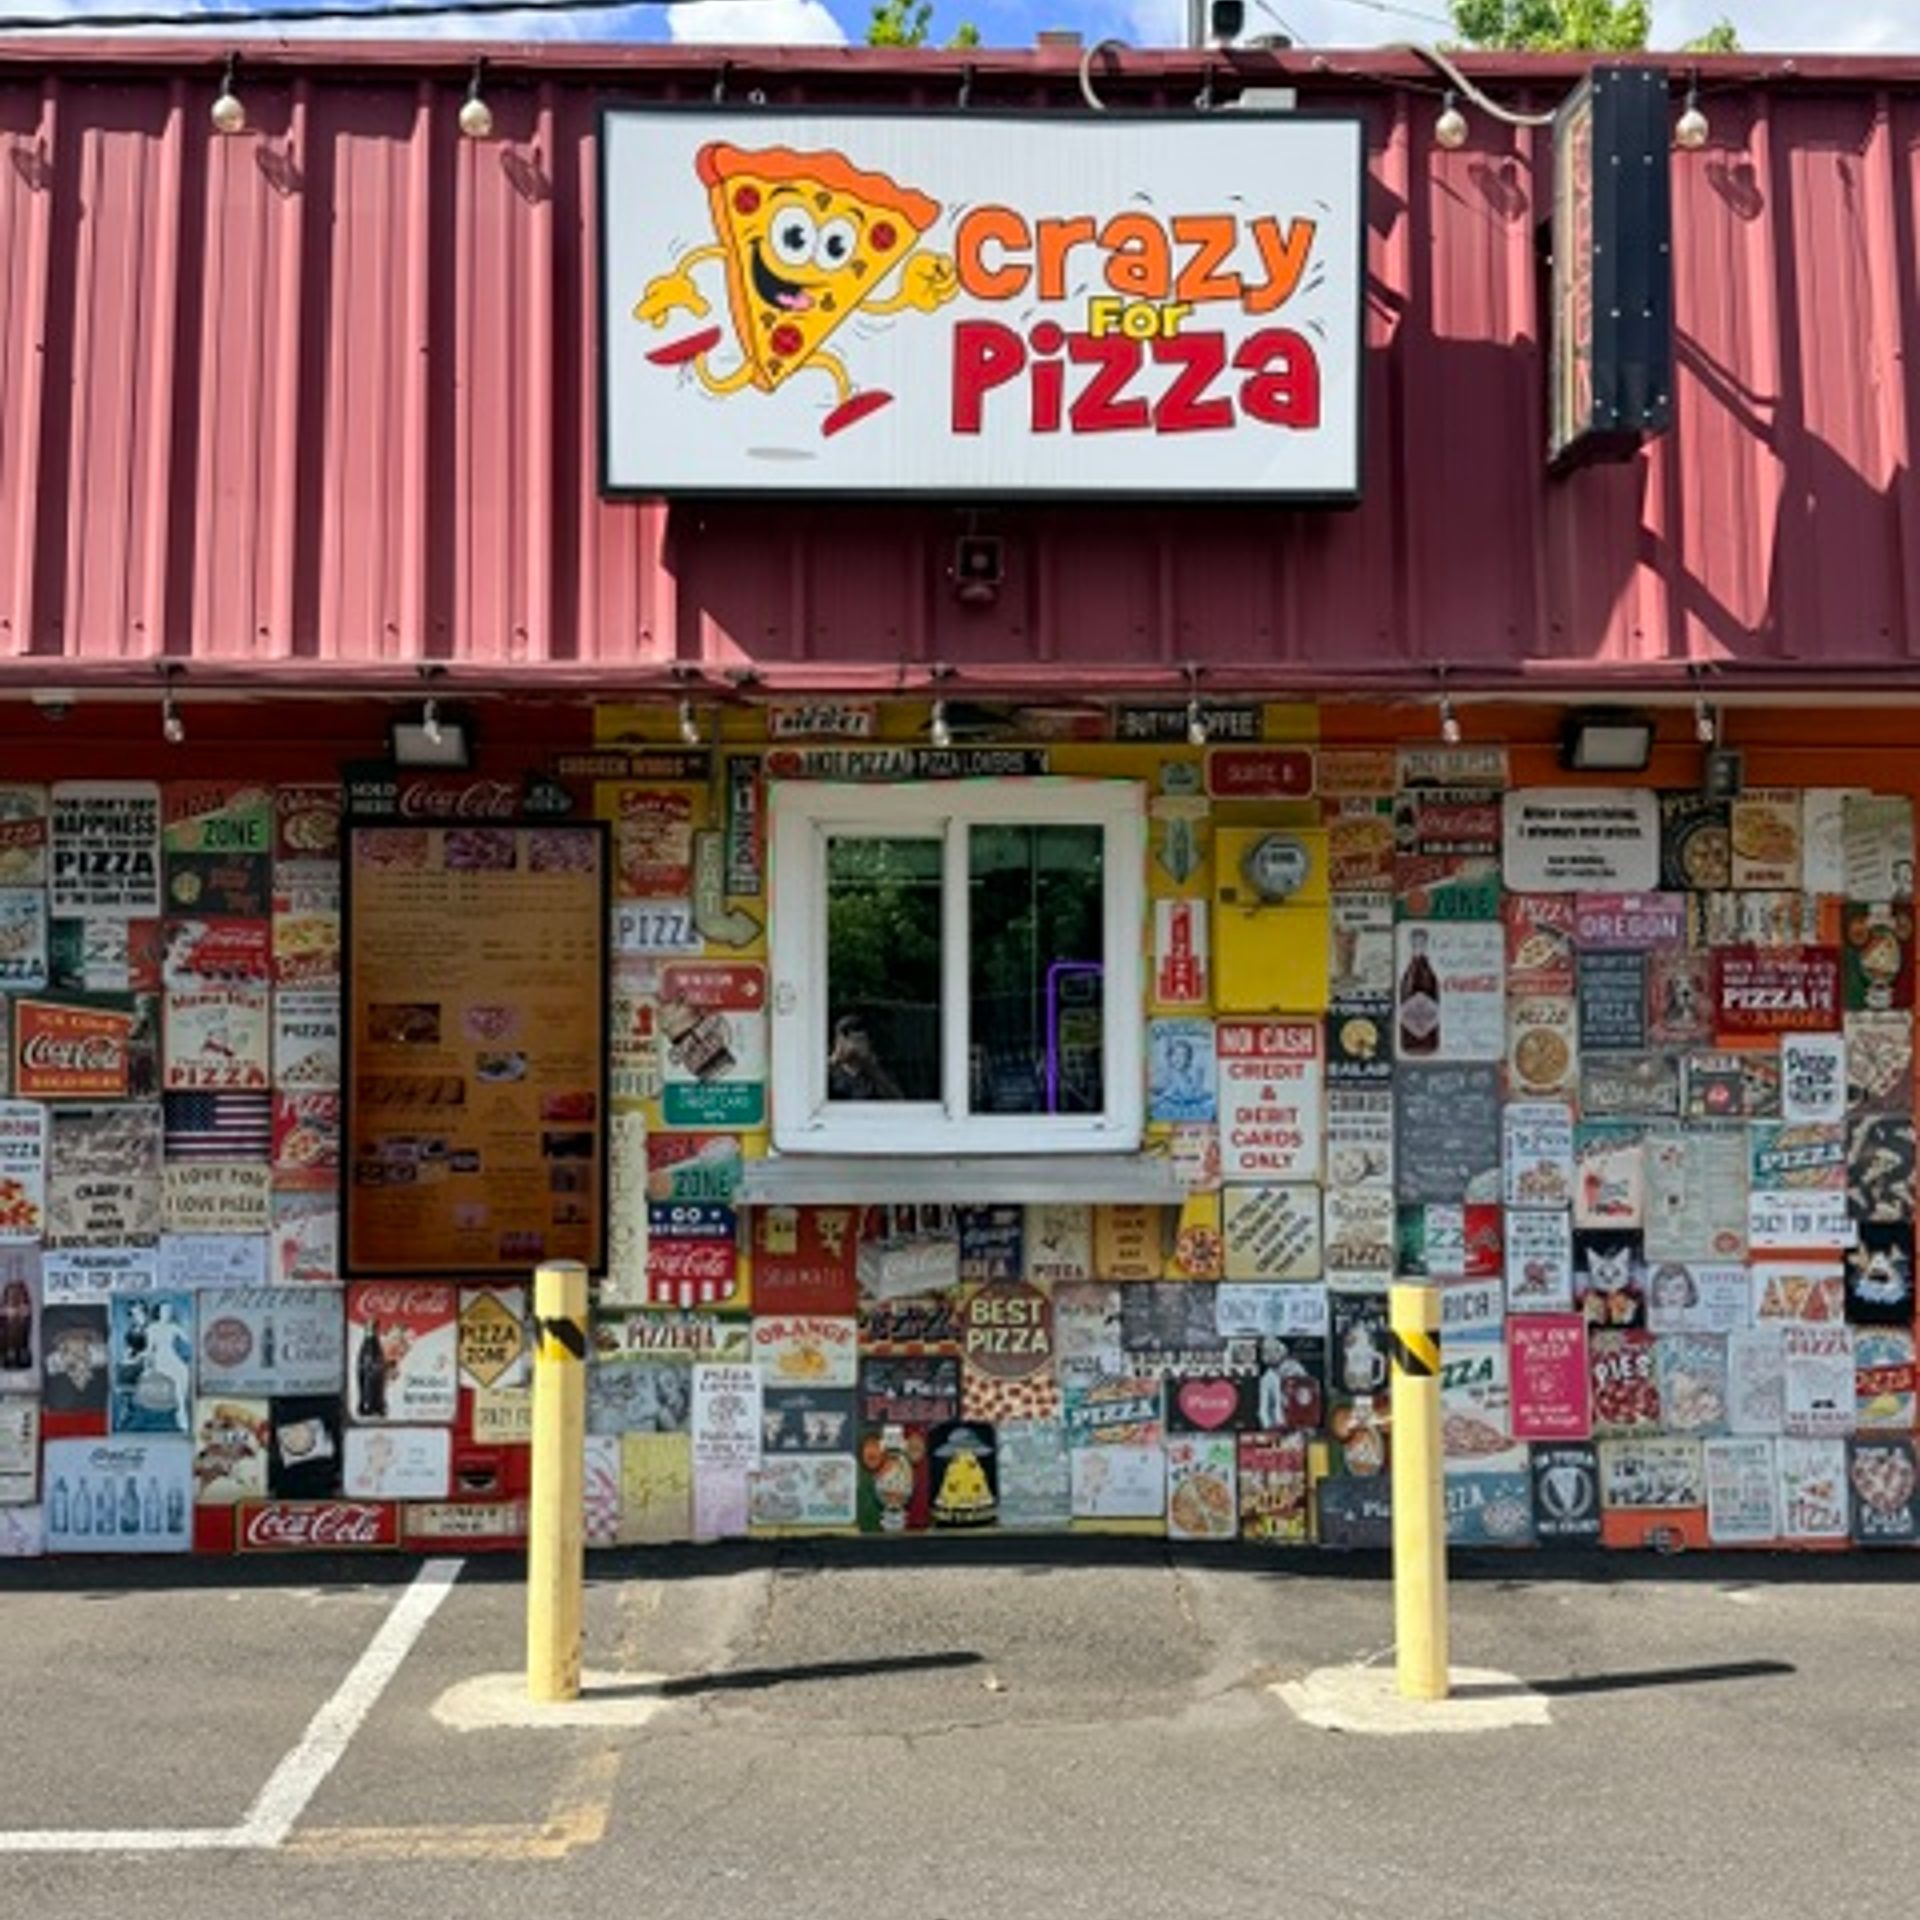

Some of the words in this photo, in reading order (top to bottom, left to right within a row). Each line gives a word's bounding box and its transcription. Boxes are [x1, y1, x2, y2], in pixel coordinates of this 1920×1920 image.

[954, 205, 1317, 314] Crazy
[1088, 297, 1194, 339] For
[951, 320, 1321, 433] Pizza
[203, 819, 260, 846] ZONE
[54, 852, 155, 874] PIZZA
[1579, 914, 1678, 938] OREGON
[1722, 986, 1806, 1010] PIZZA
[1220, 1027, 1252, 1053] NO
[1258, 1027, 1313, 1053] CASH
[170, 1066, 266, 1085] PIZZA
[1228, 1063, 1305, 1080] CREDIT
[1260, 1084, 1276, 1101] &
[1236, 1107, 1298, 1124] DEBIT
[1231, 1132, 1301, 1149] CARDS
[1240, 1151, 1294, 1169] ONLY
[671, 1206, 702, 1223] GO
[970, 1301, 1044, 1324] BEST
[459, 1324, 516, 1345] PIZZA
[756, 1317, 851, 1346] ORANGE
[965, 1328, 1049, 1355] PIZZA
[465, 1346, 509, 1363] ZONE
[1441, 1356, 1494, 1389] ZZA
[1595, 1353, 1650, 1387] PIES
[1075, 1399, 1157, 1425] PIZZA
[246, 1505, 383, 1546] Coca-Cola
